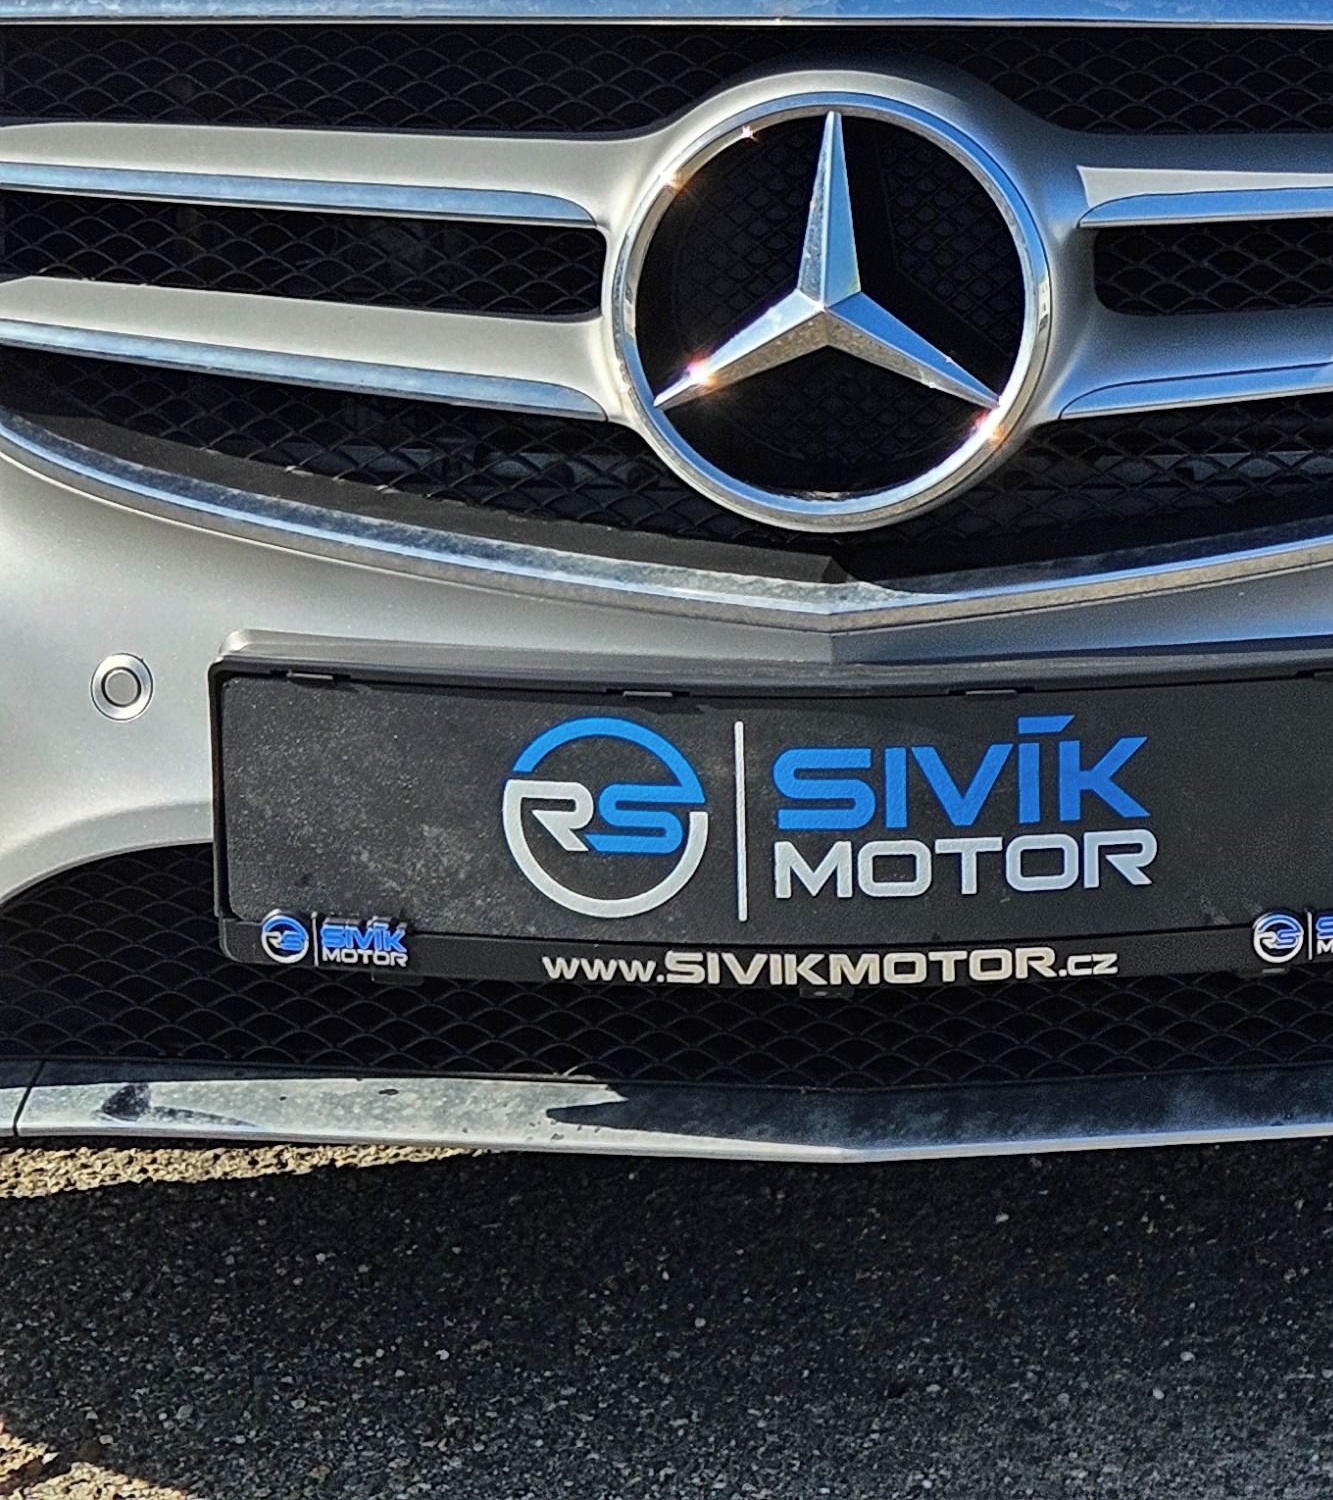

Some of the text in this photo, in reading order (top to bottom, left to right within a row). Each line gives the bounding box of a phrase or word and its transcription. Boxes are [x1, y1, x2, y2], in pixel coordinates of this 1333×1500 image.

[774, 828, 1158, 899] MOTOR
[322, 948, 409, 967] MOTOR
[541, 947, 1118, 985] www.SIVIKMOTOR.cz
